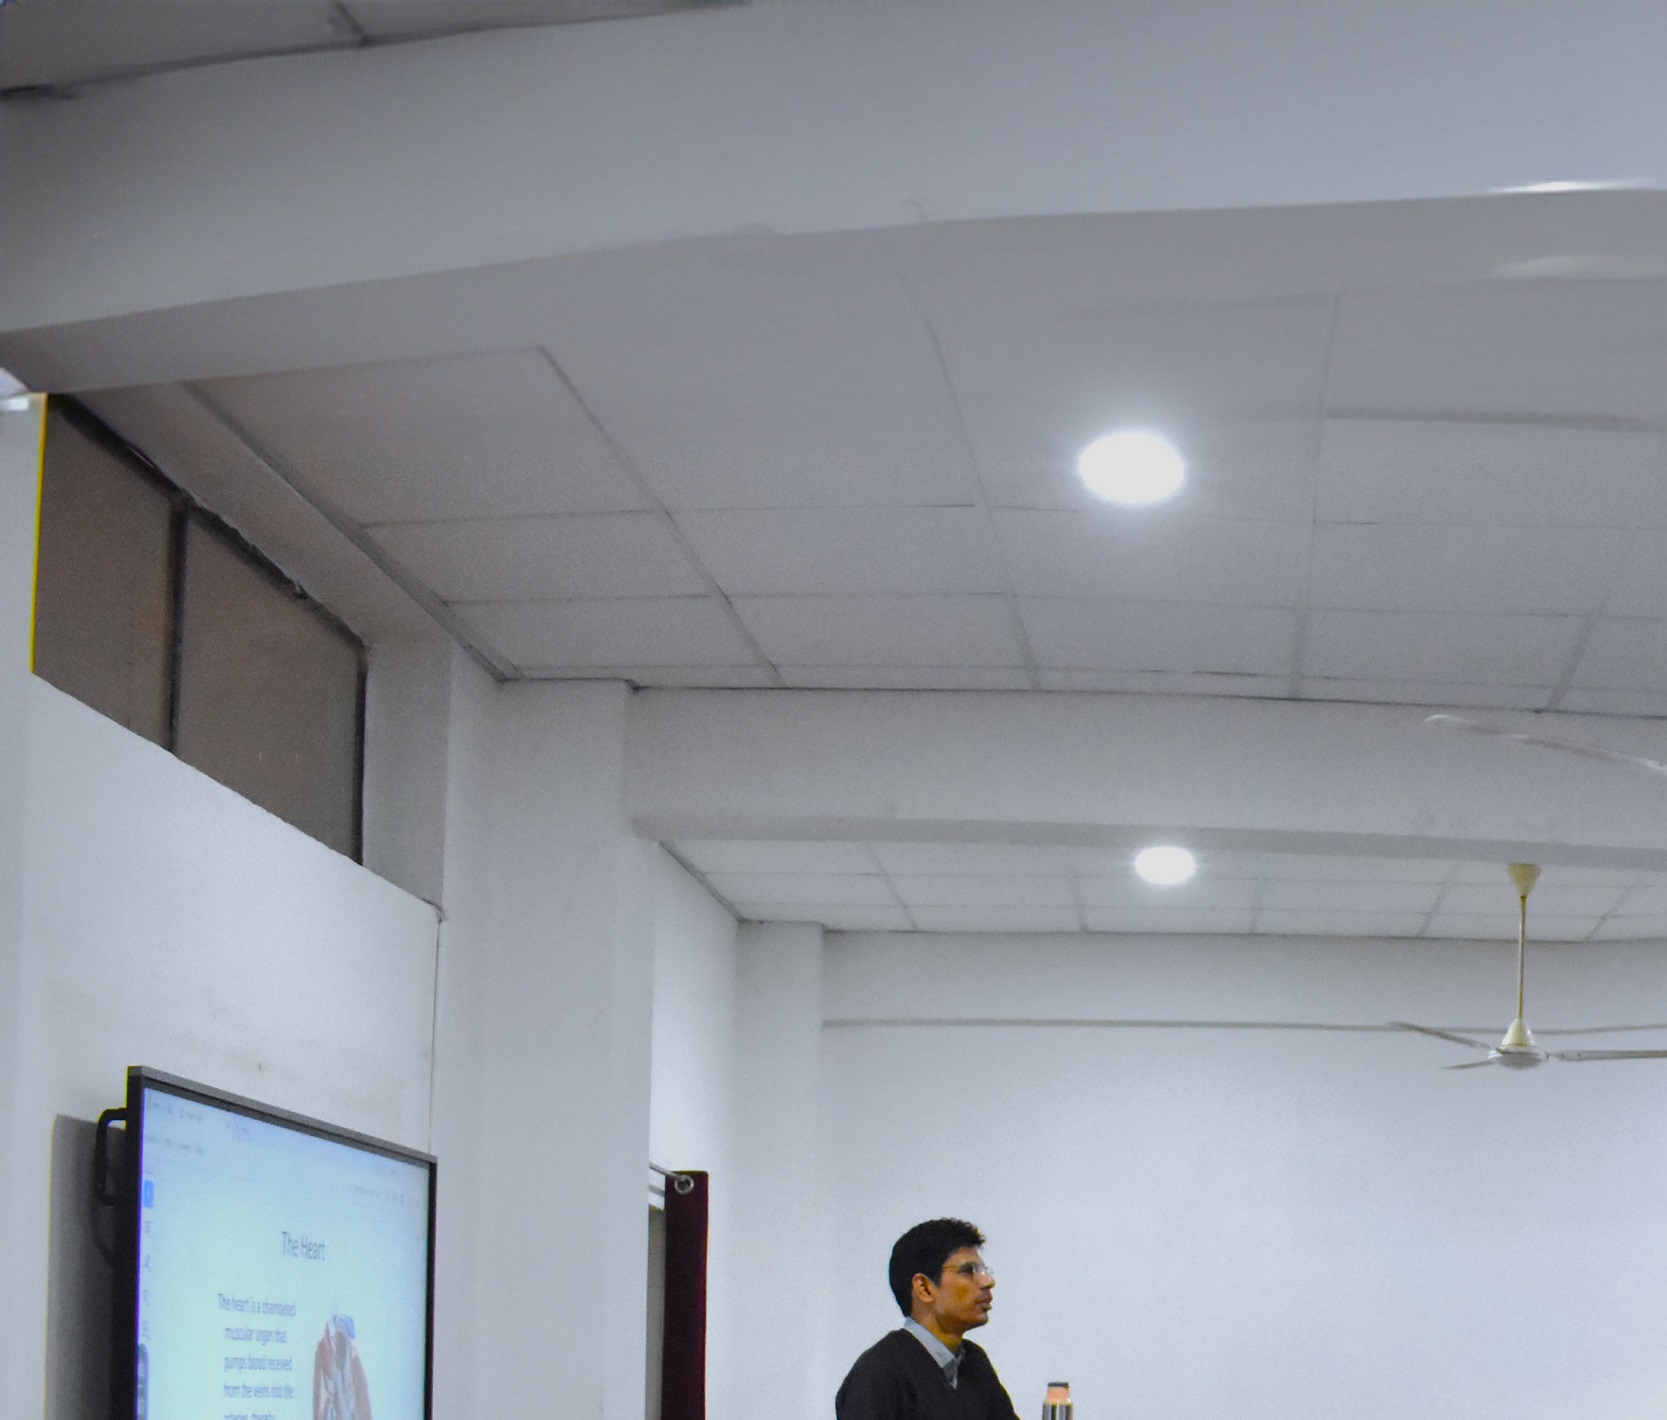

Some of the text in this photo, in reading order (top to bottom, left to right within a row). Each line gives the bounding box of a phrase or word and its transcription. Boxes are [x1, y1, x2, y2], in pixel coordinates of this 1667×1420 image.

[281, 1230, 326, 1262] The Heart
[218, 1293, 231, 1311] The
[231, 1296, 250, 1313] heart
[224, 1353, 293, 1373] pumps blood received
[223, 1381, 240, 1398] from
[241, 1381, 252, 1398] the
